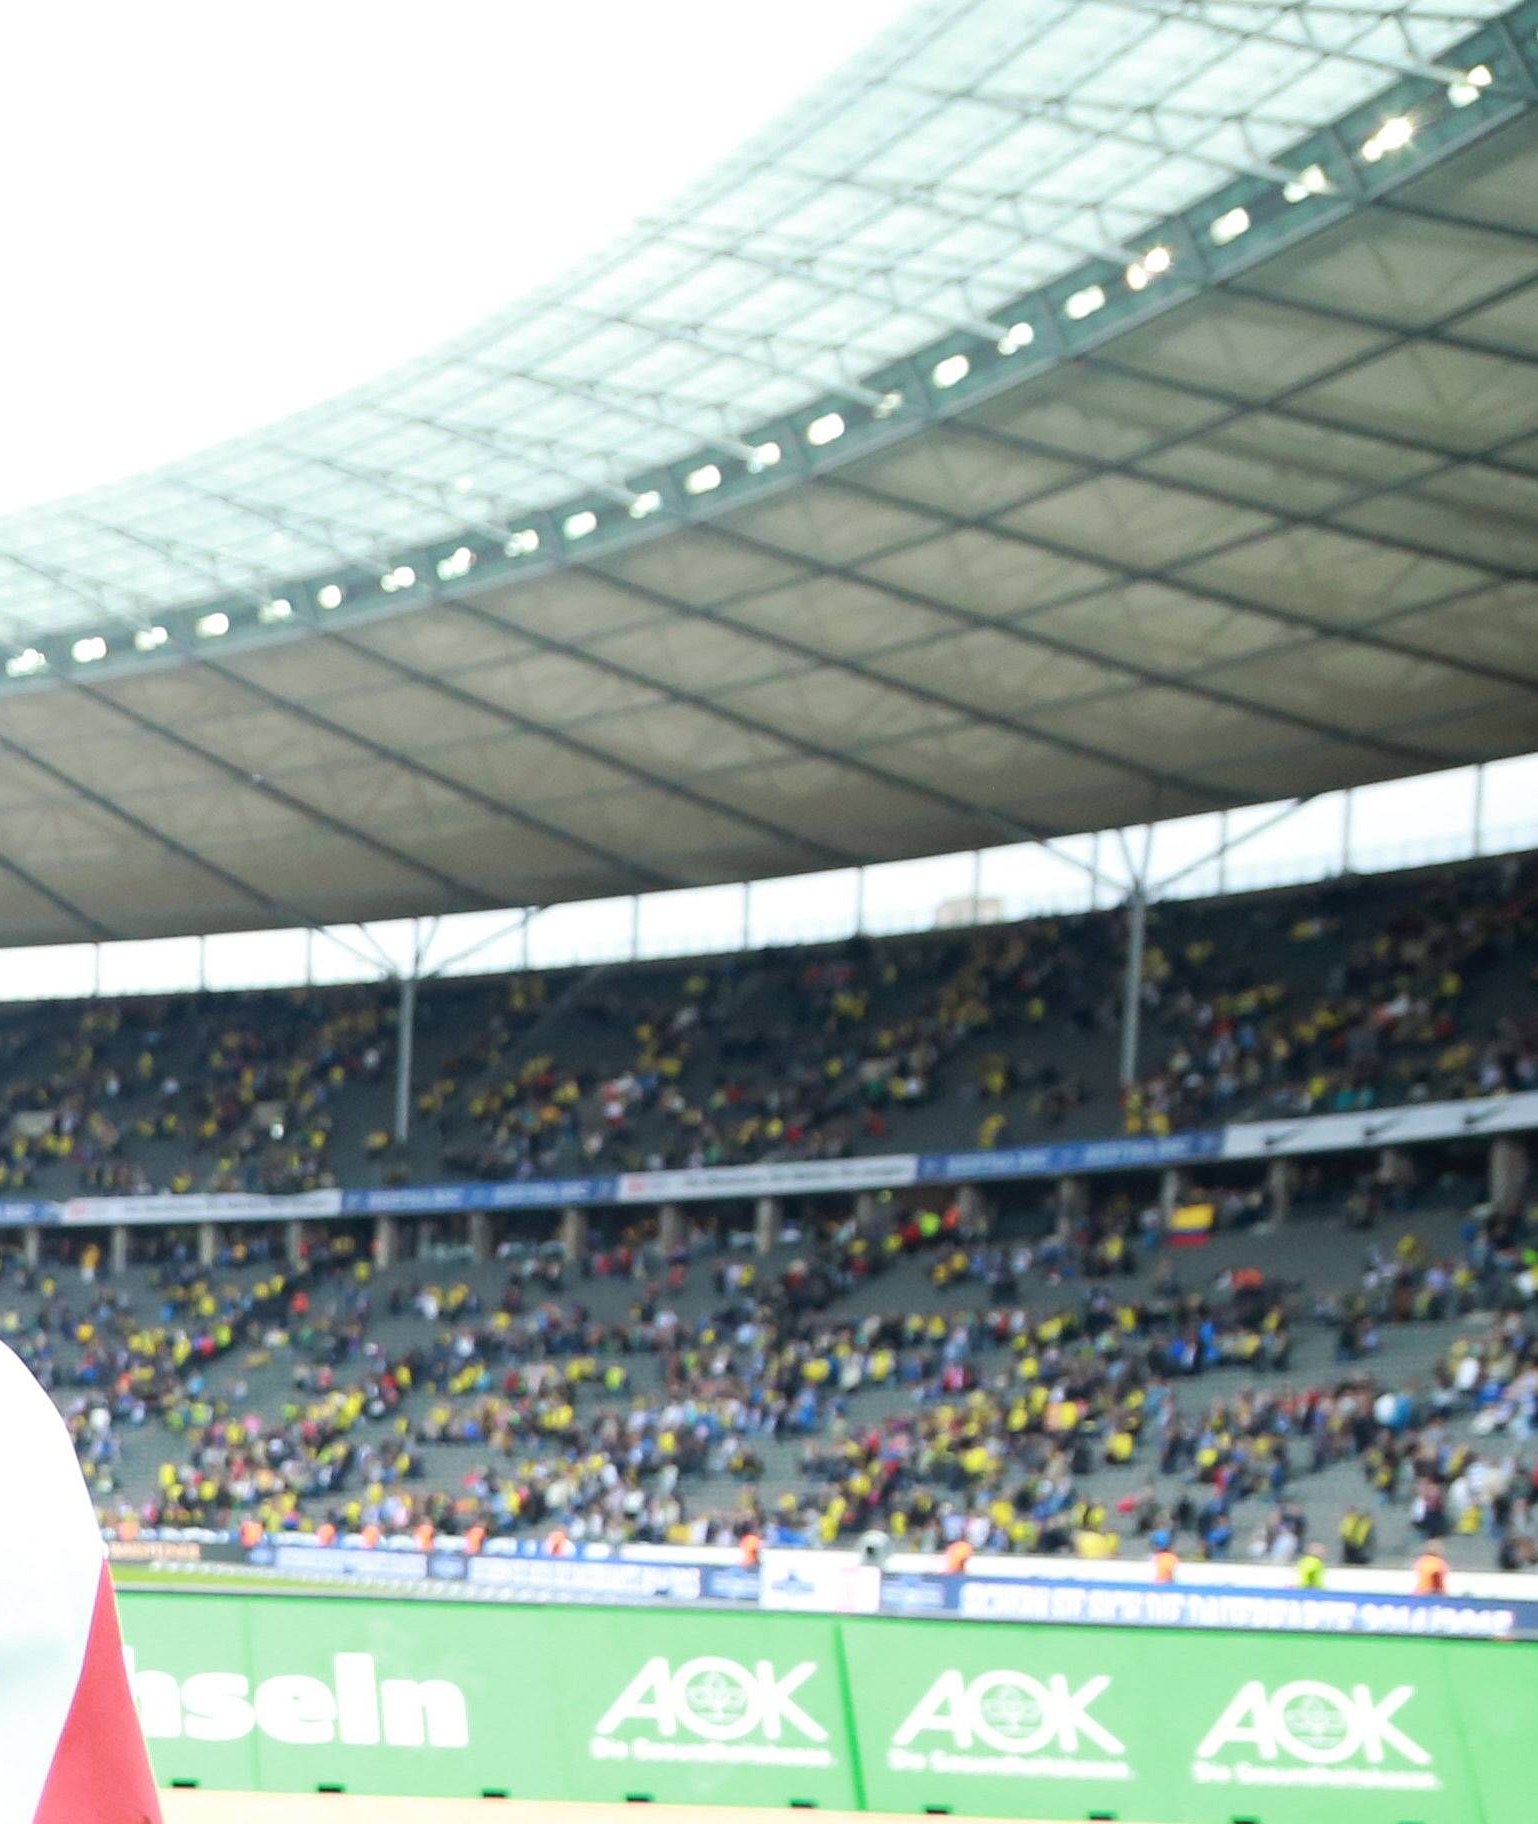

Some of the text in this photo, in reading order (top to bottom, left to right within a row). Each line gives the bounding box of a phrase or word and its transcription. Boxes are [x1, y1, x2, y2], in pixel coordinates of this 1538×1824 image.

[595, 1656, 829, 1741] AOK
[892, 1669, 1126, 1755] AOK
[1196, 1680, 1433, 1765] AOK
